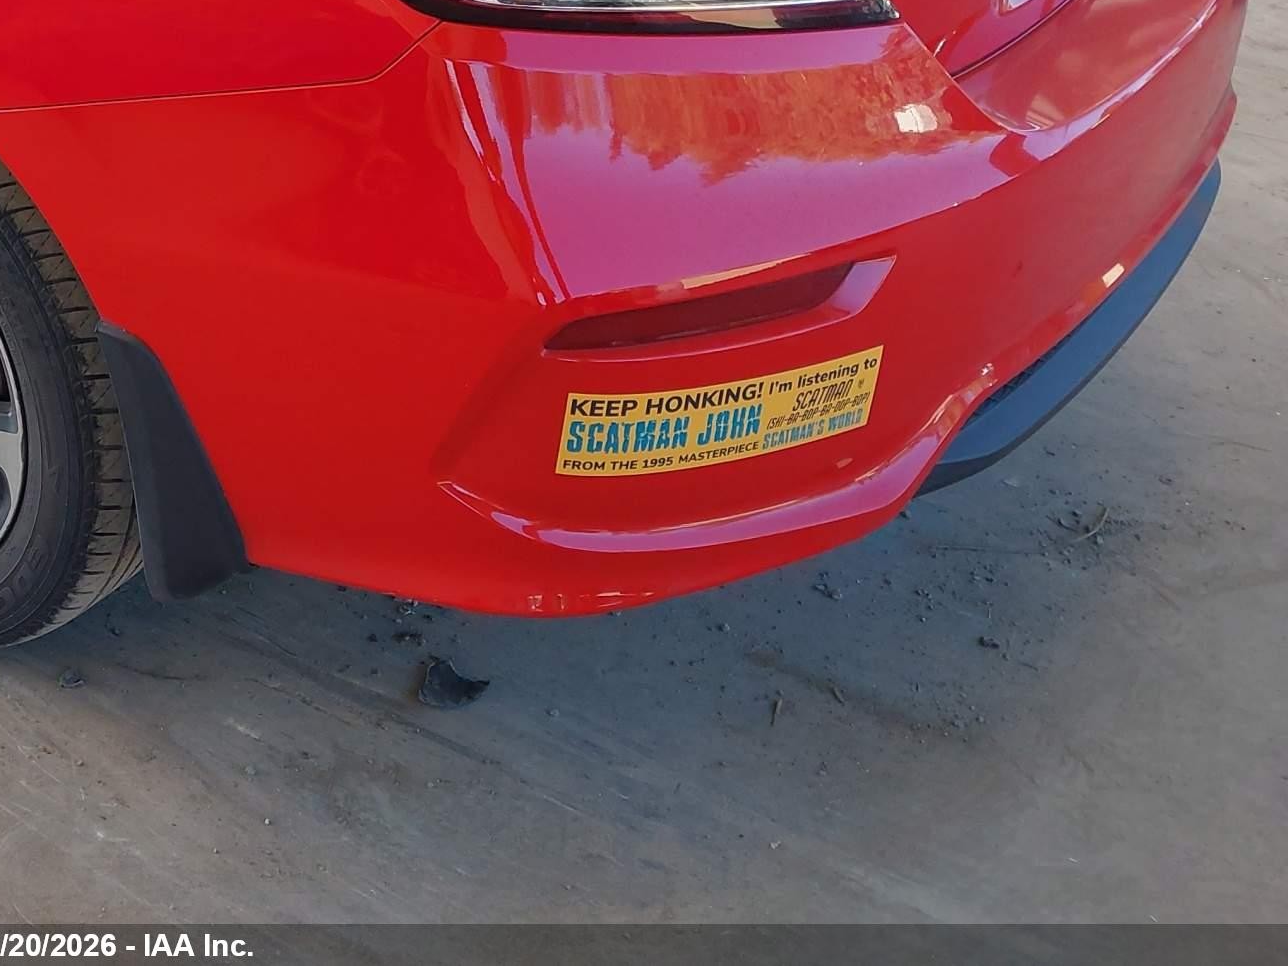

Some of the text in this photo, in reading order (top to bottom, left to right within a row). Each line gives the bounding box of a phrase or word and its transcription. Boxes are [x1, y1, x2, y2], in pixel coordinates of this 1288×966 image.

[570, 358, 878, 417] KEEP HONKING! I'm listening to
[792, 379, 854, 412] SCATMAN
[563, 408, 864, 470] FROM THE 1995 MASTERPIECE SCATMAN'S WORLD
[567, 403, 762, 454] SCATMAN JOHN
